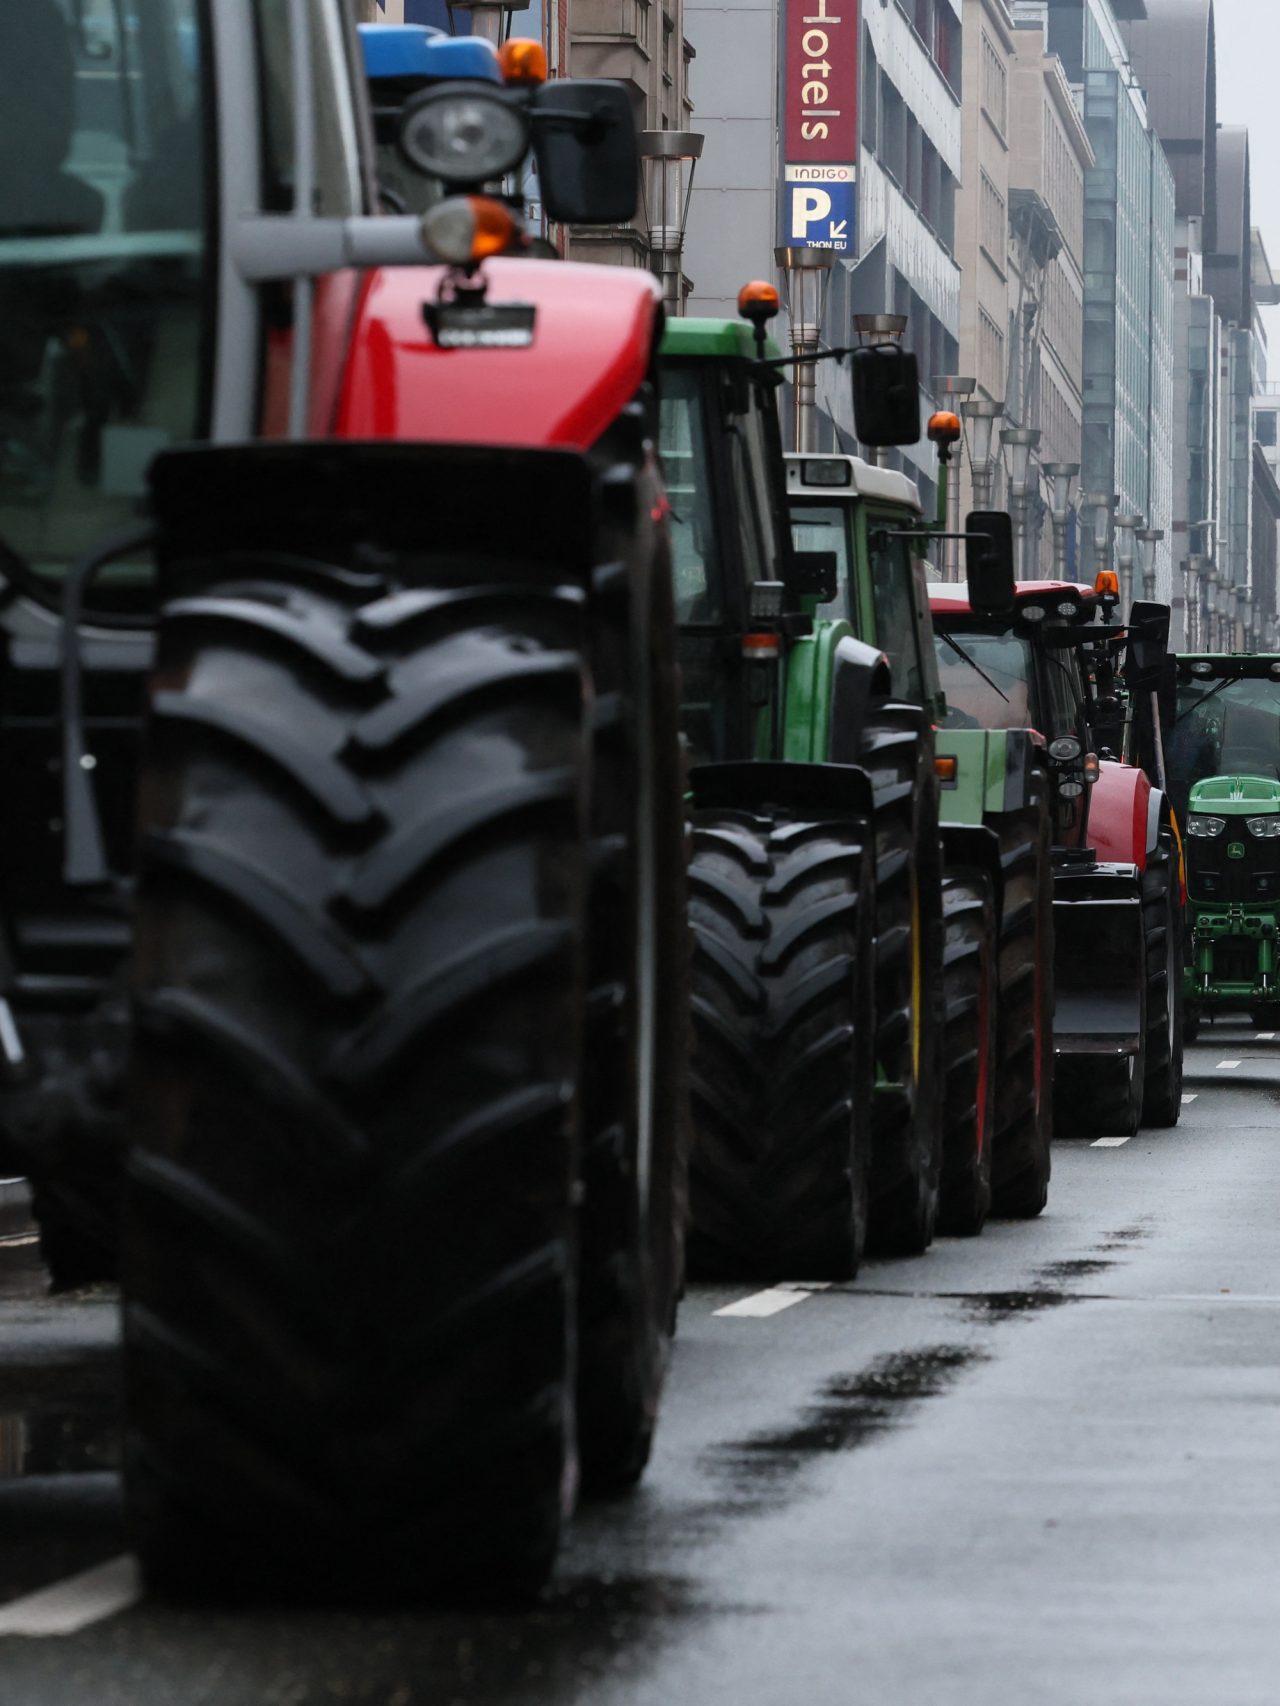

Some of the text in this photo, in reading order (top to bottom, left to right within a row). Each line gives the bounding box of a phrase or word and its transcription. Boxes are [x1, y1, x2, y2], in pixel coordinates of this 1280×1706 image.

[792, 187, 832, 239] P
[806, 240, 847, 250] THON EU
